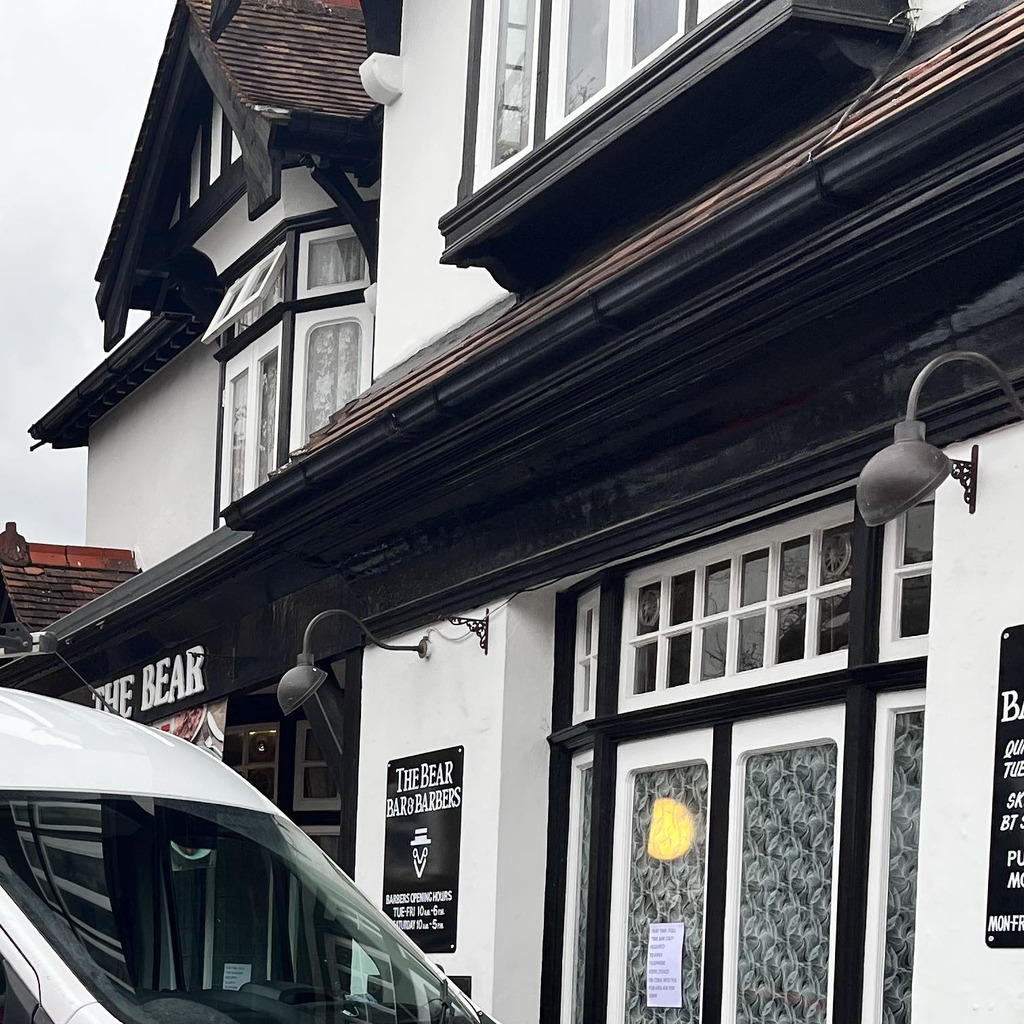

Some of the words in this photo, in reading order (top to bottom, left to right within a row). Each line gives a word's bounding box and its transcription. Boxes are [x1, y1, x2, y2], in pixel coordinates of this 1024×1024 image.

[92, 674, 135, 718] THE
[141, 645, 205, 711] BEAR
[395, 767, 419, 793] THE
[420, 761, 454, 788] BEAR
[1000, 814, 1019, 831] BT
[432, 890, 453, 902] HOURS
